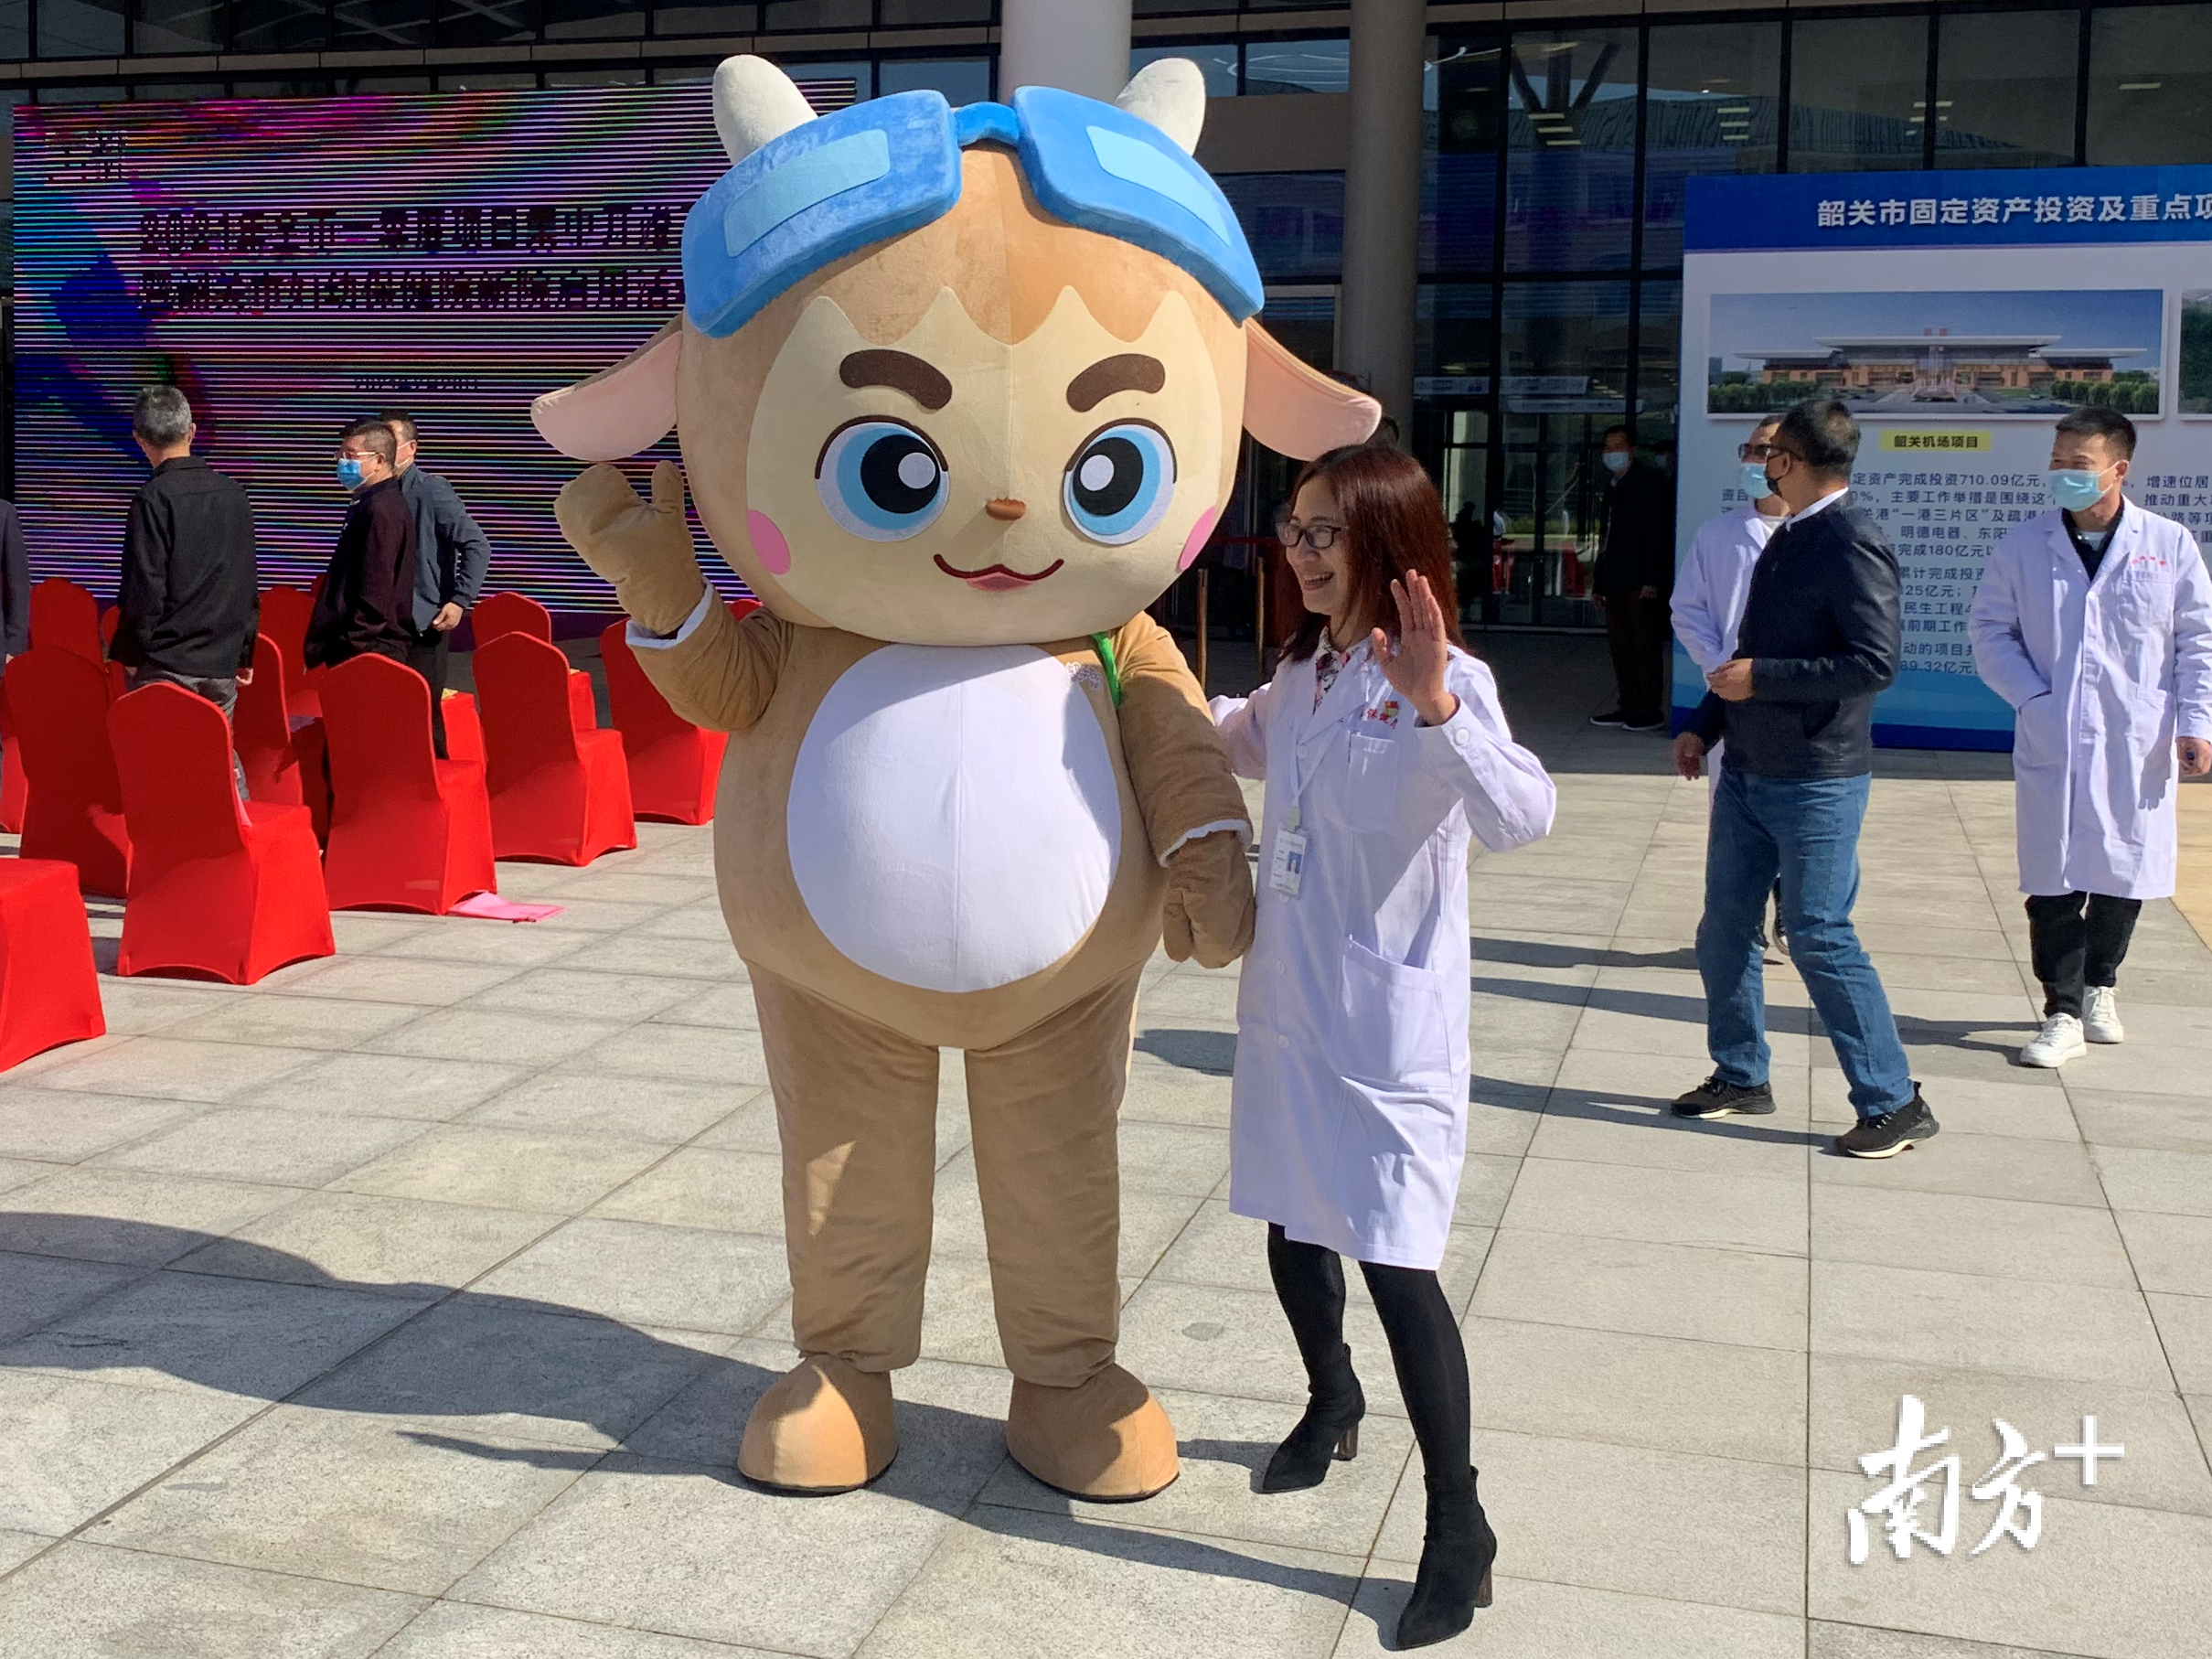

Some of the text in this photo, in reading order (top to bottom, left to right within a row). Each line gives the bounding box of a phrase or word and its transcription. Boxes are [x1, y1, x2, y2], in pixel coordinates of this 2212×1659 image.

[1818, 193, 2212, 226] 韶关市固定资产投资及重点项
[1894, 435, 1979, 448] 韶关机场项目
[2144, 494, 2212, 506] 推动重大
